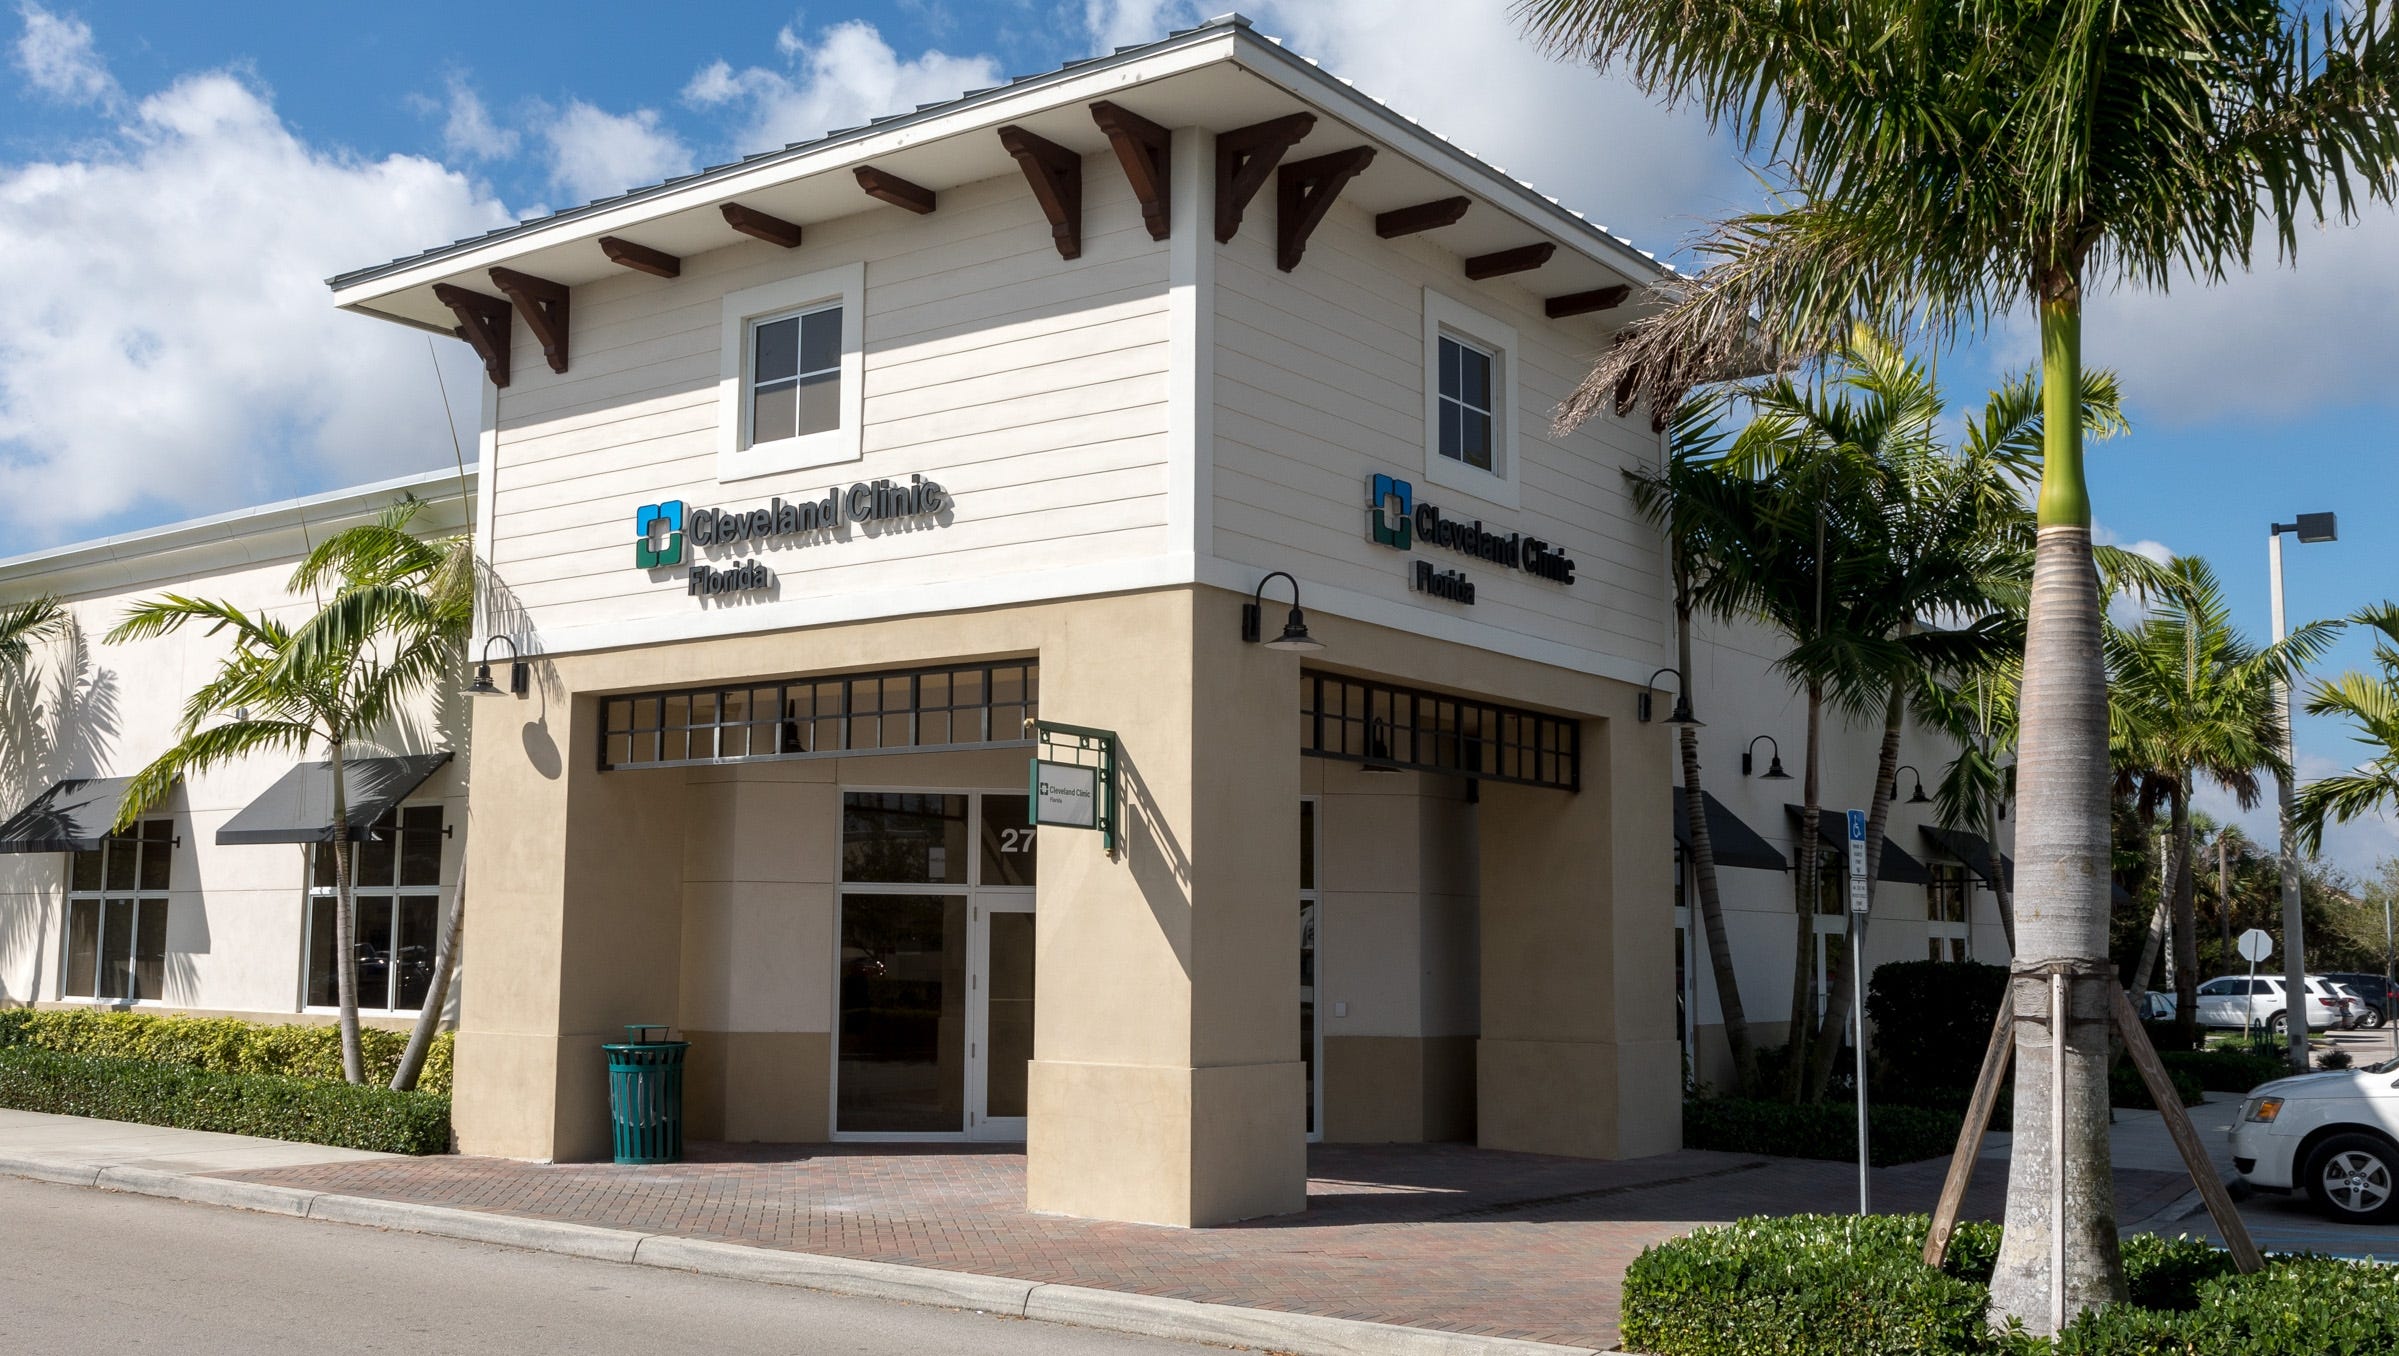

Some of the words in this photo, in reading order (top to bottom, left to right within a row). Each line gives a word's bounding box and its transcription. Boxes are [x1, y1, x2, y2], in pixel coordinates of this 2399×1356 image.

[688, 487, 842, 547] Cleveland
[846, 473, 944, 523] Clinic
[1415, 502, 1519, 569] Cleveland
[1521, 536, 1576, 586] Clinic
[688, 558, 771, 596] Florida
[1416, 560, 1475, 606] Florida
[1049, 785, 1075, 796] Cleveland
[1075, 788, 1091, 798] Clinic
